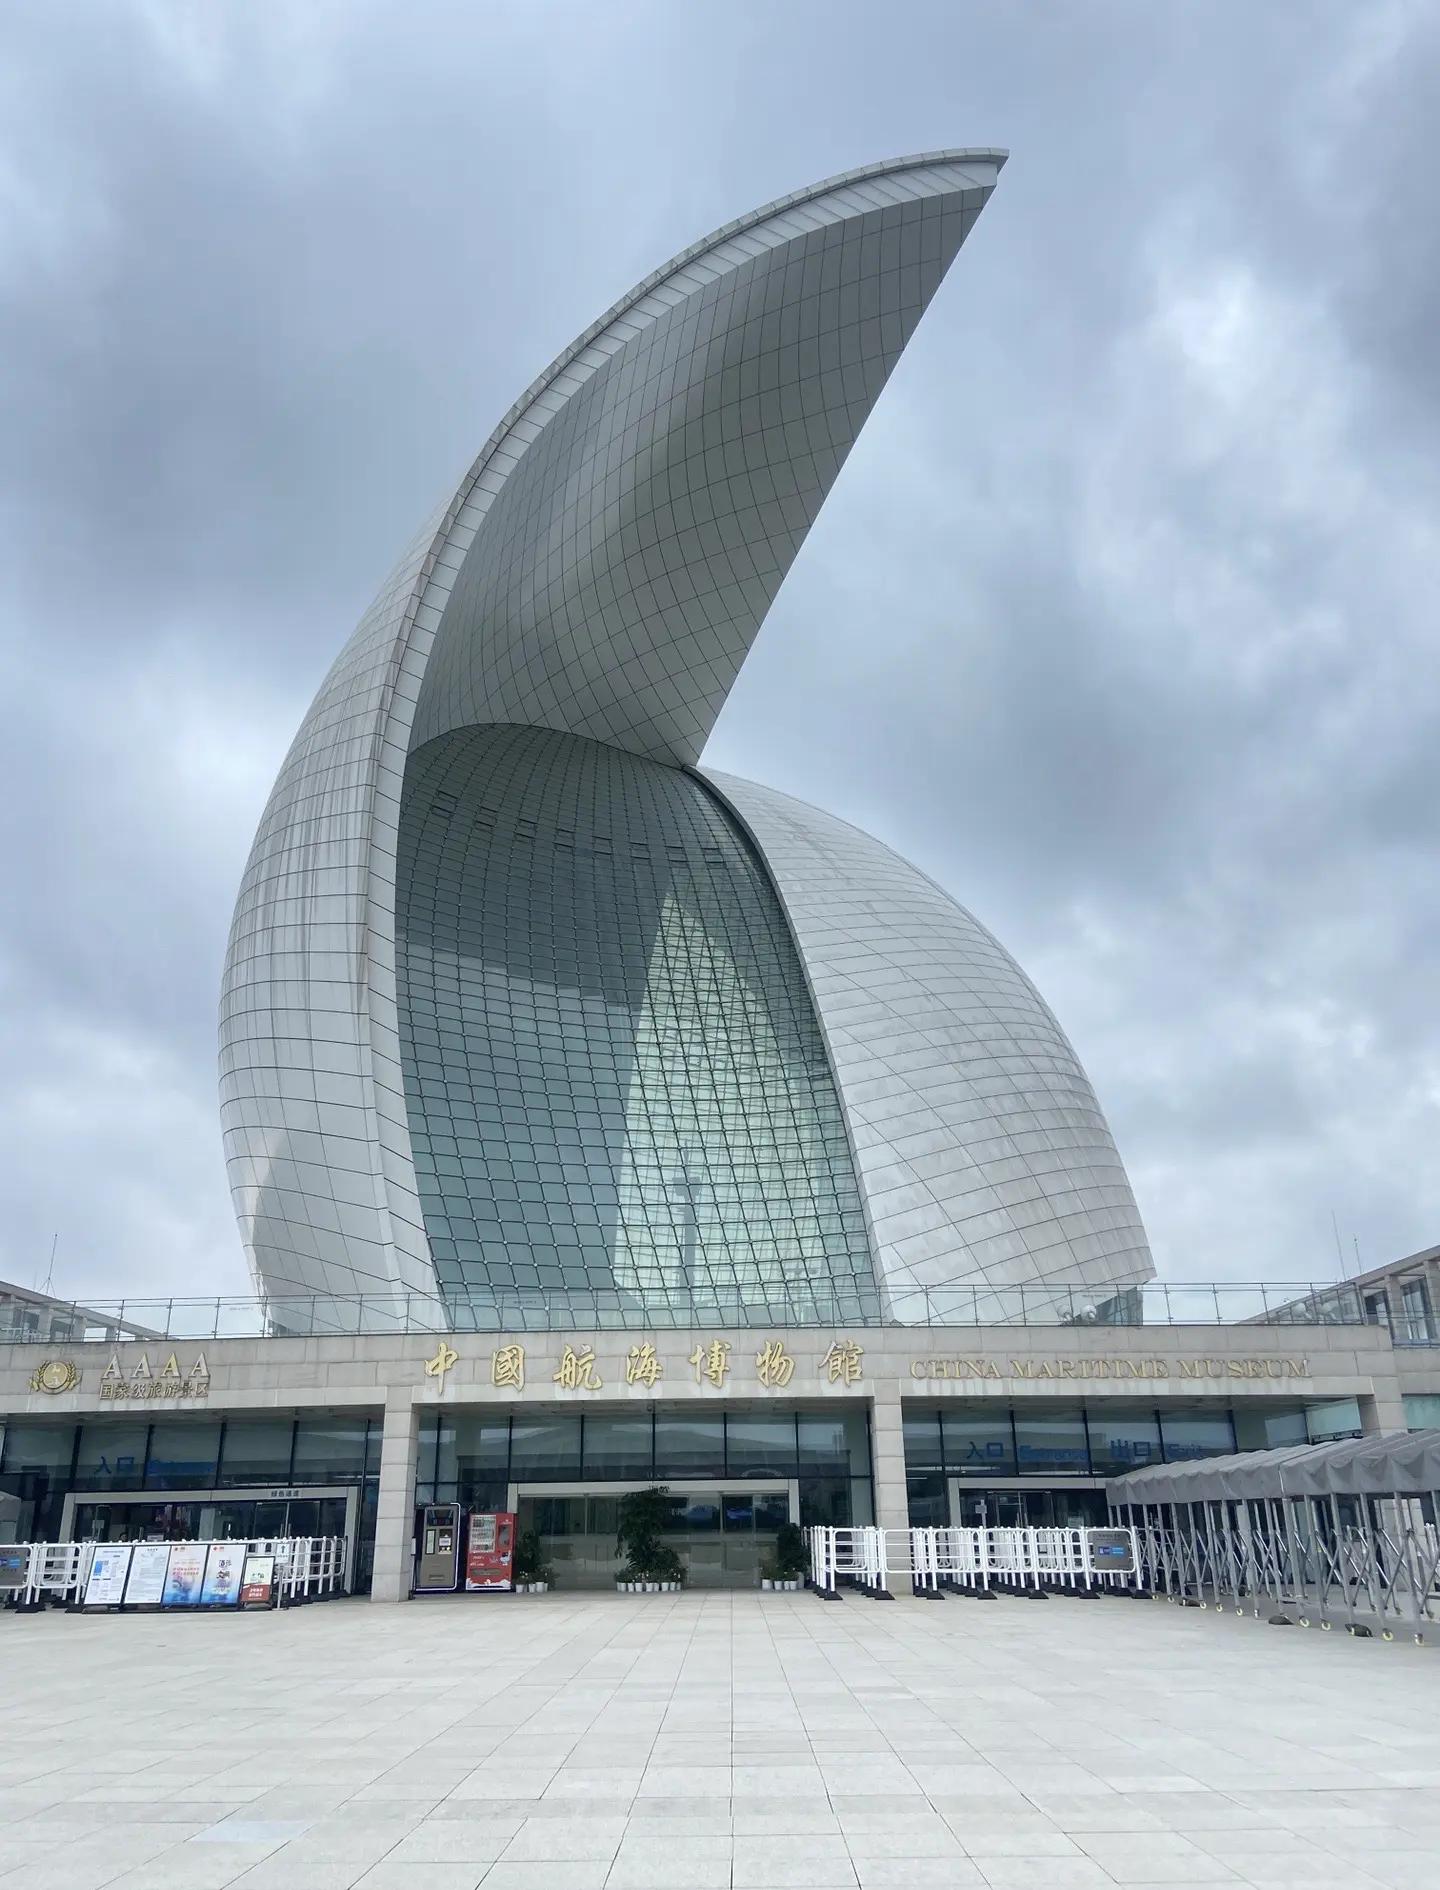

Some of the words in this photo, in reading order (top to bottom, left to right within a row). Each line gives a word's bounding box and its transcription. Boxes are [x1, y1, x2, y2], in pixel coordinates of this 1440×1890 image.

[102, 1352, 210, 1379] AAAA
[424, 1340, 864, 1395] 中國航海博物館
[910, 1359, 1000, 1379] CHINA
[1010, 1359, 1168, 1379] MARITIME
[1178, 1359, 1312, 1378] MUSEUM
[100, 1381, 209, 1400] 国家级旅游景区
[966, 1441, 1004, 1459] 入口
[1110, 1438, 1151, 1458] 出口
